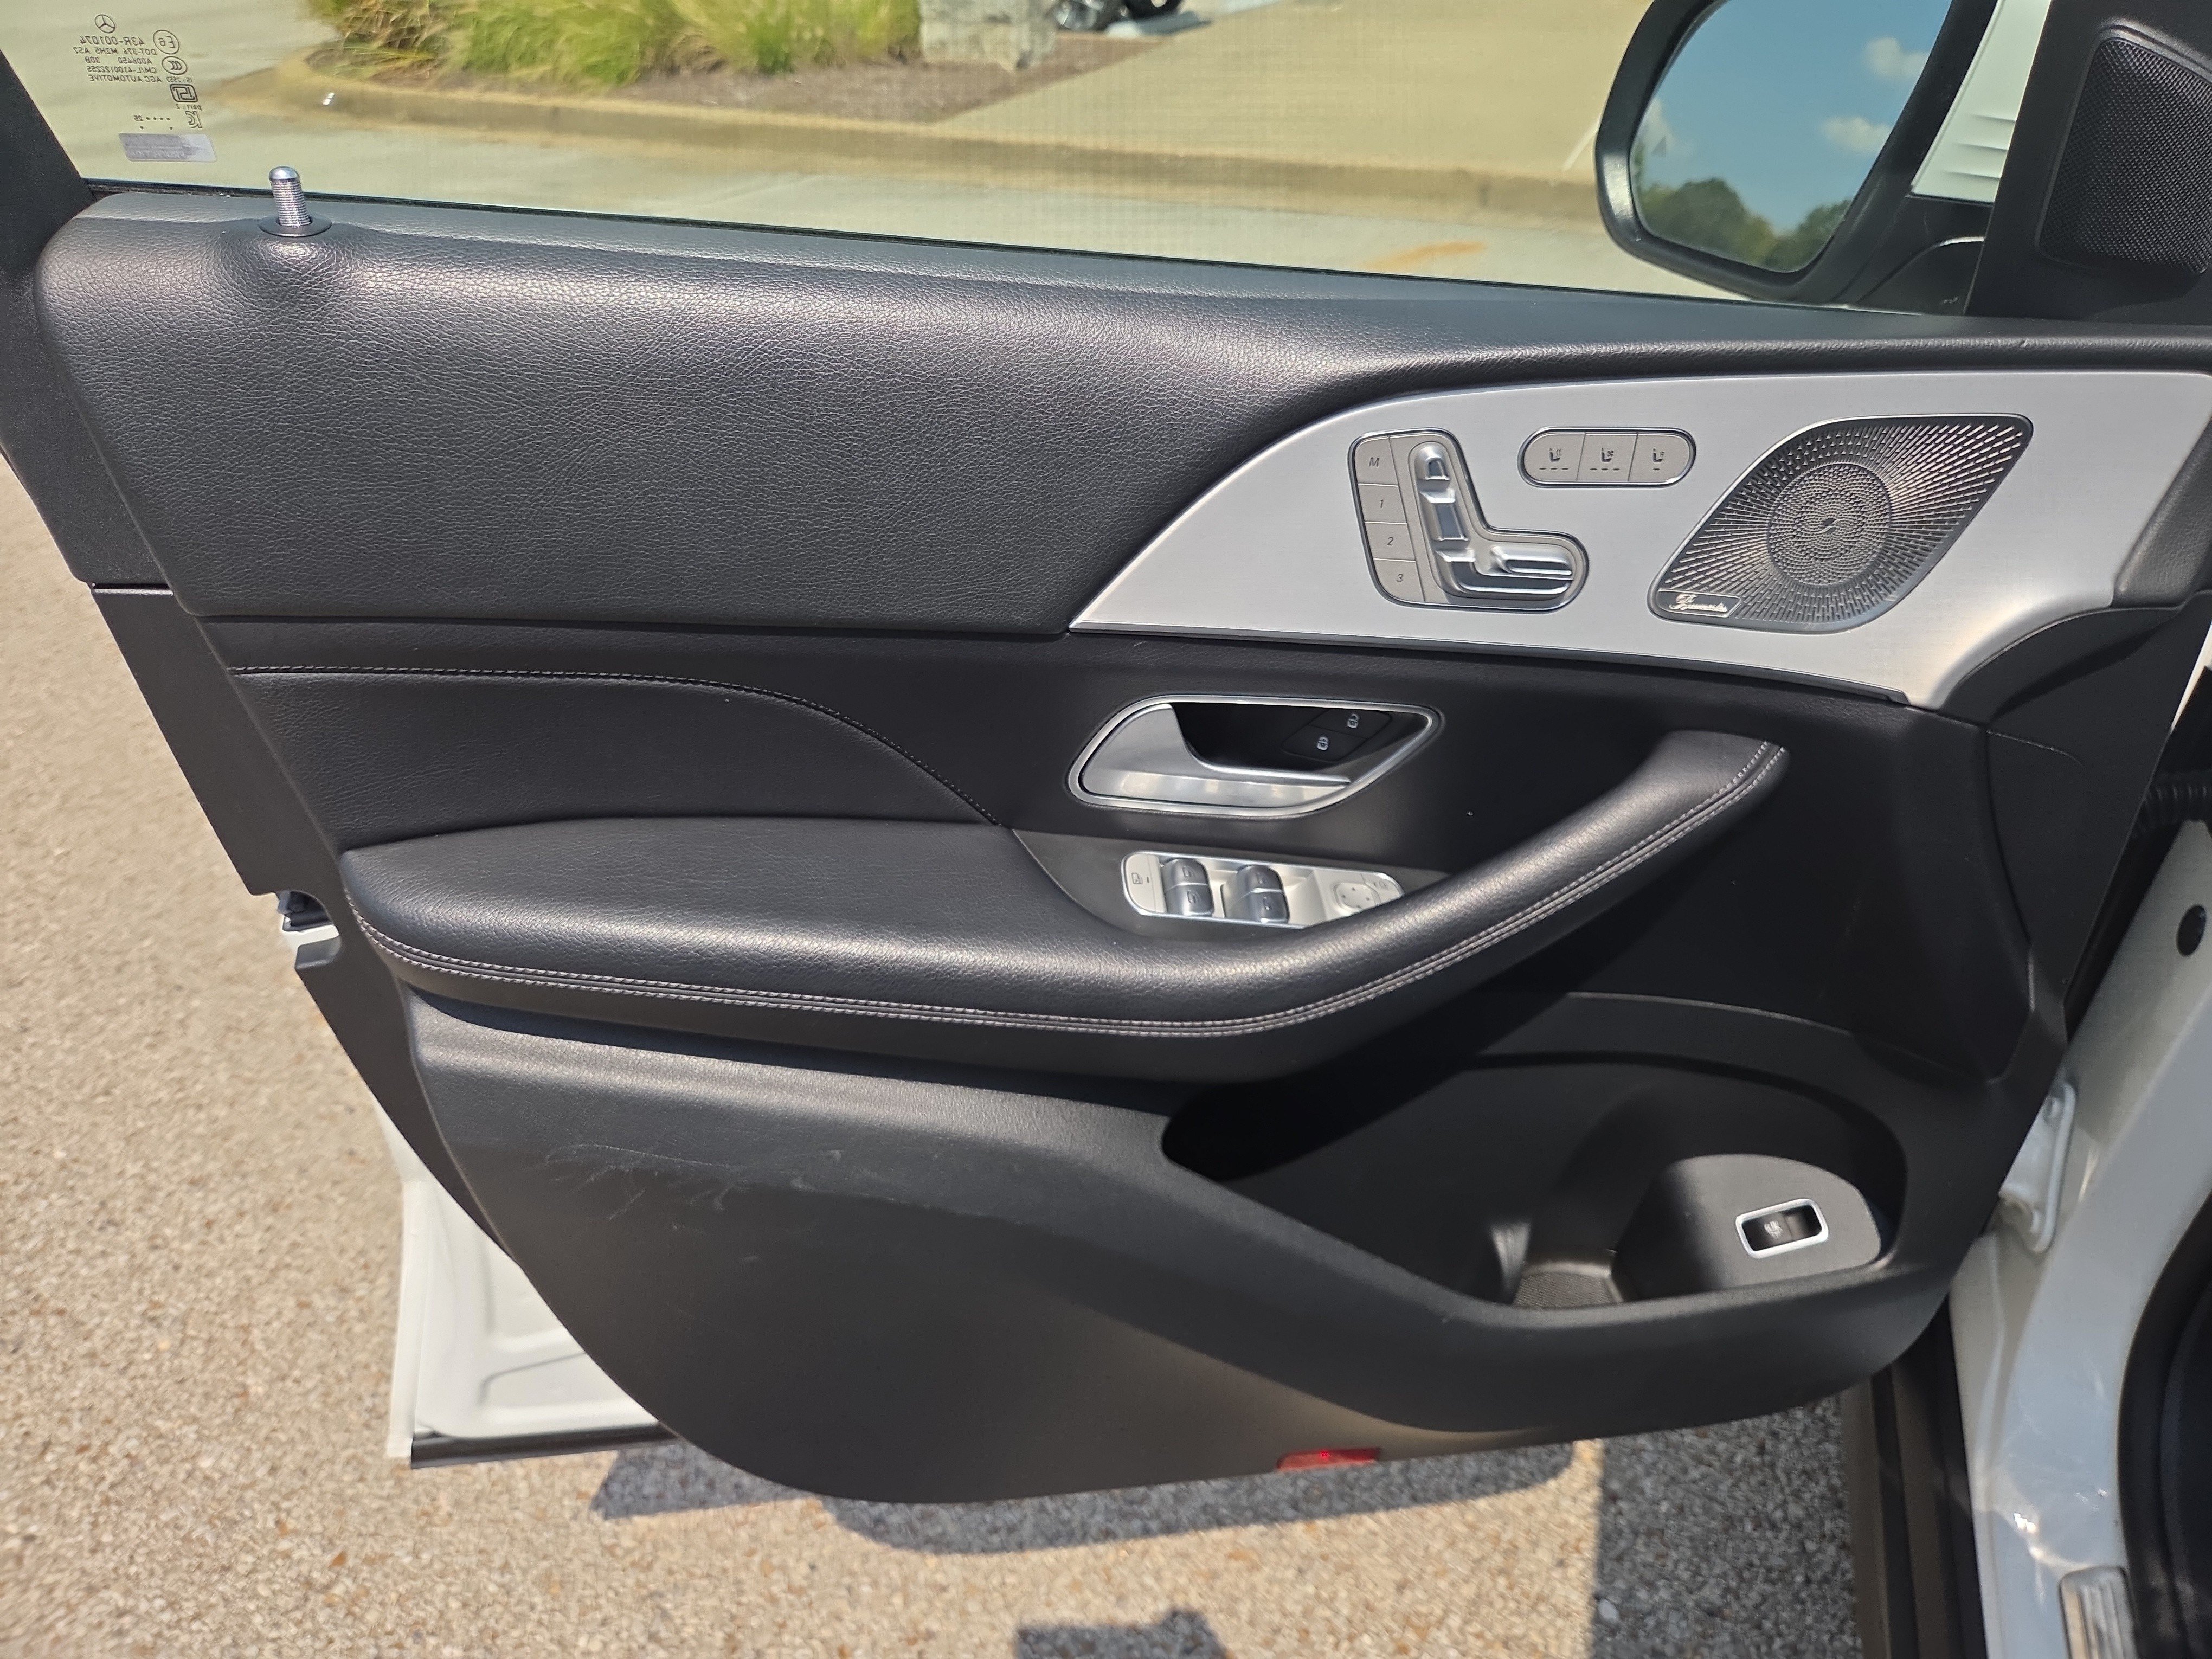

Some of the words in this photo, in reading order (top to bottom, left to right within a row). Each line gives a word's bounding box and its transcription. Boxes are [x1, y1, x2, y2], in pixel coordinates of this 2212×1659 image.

[1368, 458, 1380, 467] M
[1379, 499, 1384, 509] 1
[1386, 537, 1394, 546] 2
[1396, 573, 1404, 583] 3
